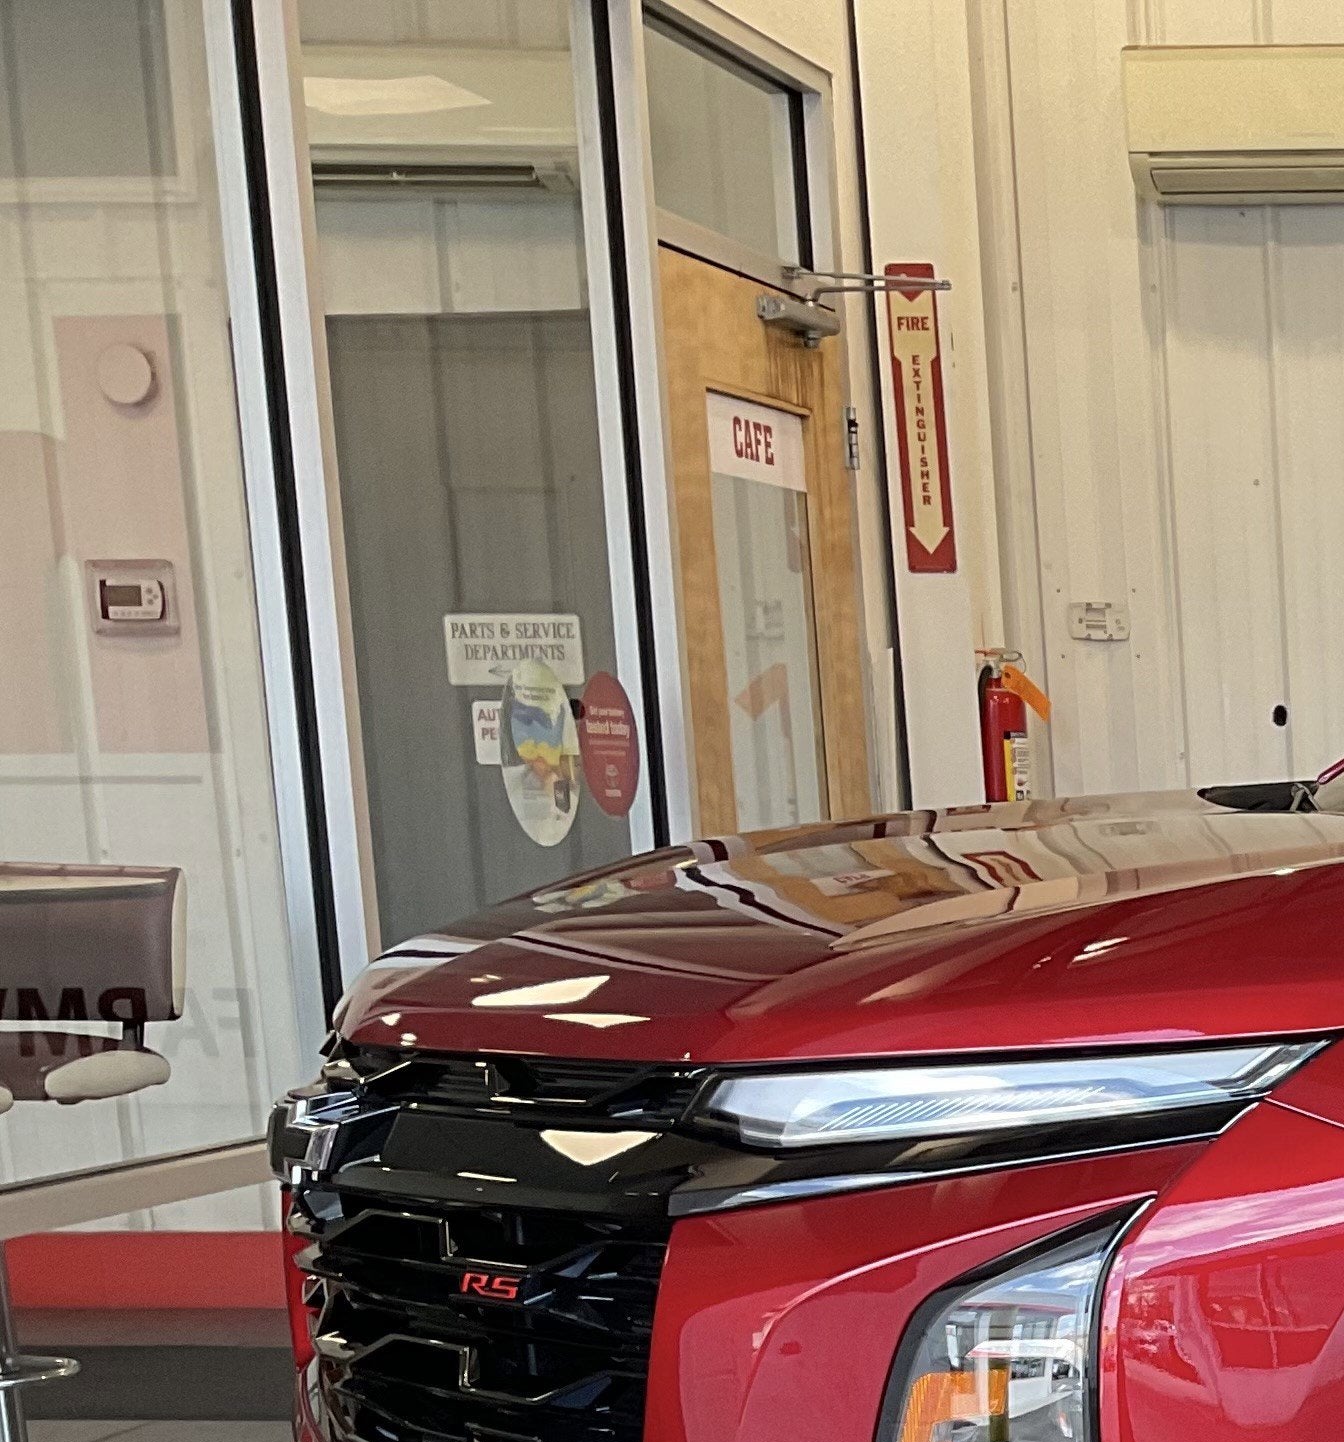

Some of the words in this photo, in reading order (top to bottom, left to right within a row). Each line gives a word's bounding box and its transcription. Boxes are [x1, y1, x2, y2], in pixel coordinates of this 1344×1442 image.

[897, 316, 930, 331] FIRE
[732, 416, 775, 466] CAFE
[911, 354, 932, 506] EXTINGUISHER
[451, 622, 495, 639] PARTS
[501, 622, 511, 639] &
[515, 622, 576, 639] SERVICE
[465, 644, 566, 661] DEPARTMENTS
[461, 1272, 520, 1299] RS
